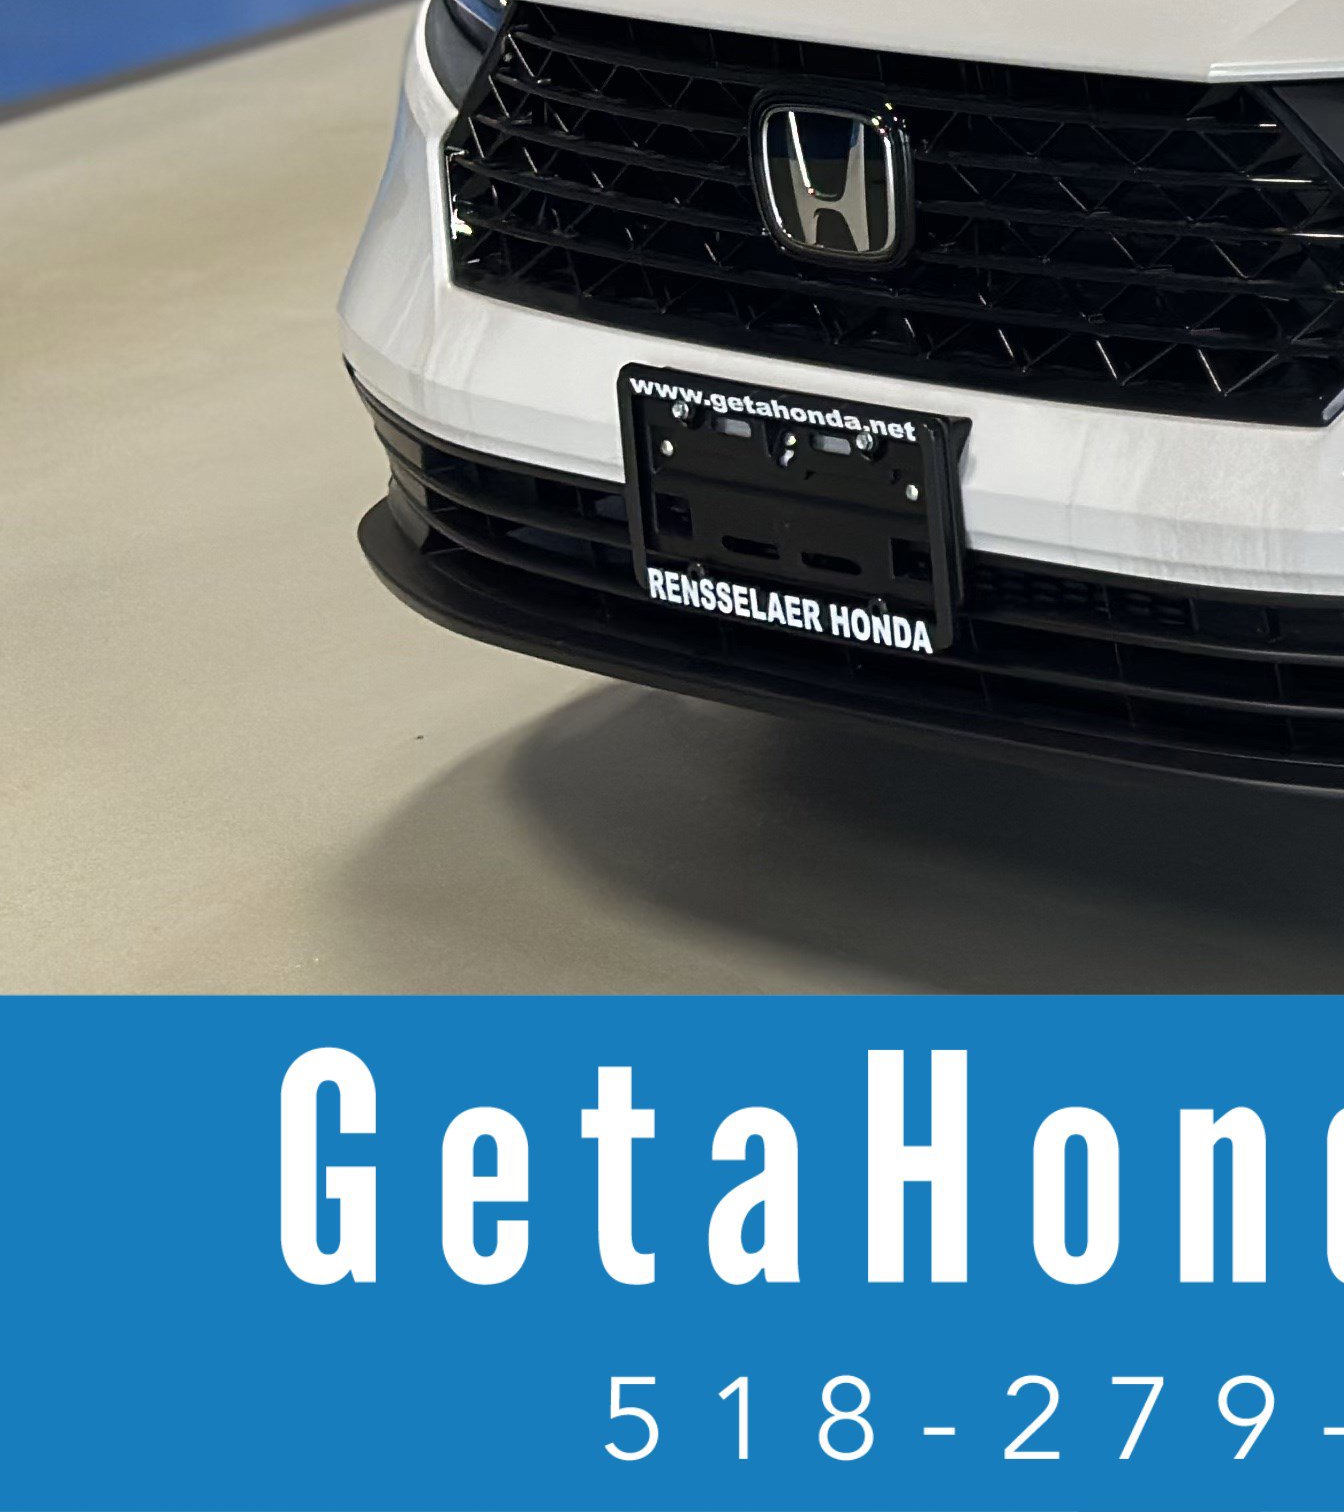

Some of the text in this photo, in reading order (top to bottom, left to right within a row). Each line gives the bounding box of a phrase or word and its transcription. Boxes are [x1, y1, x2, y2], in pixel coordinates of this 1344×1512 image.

[629, 377, 917, 442] www.getahonda.net
[647, 567, 934, 655] RENSSELAER HONDA
